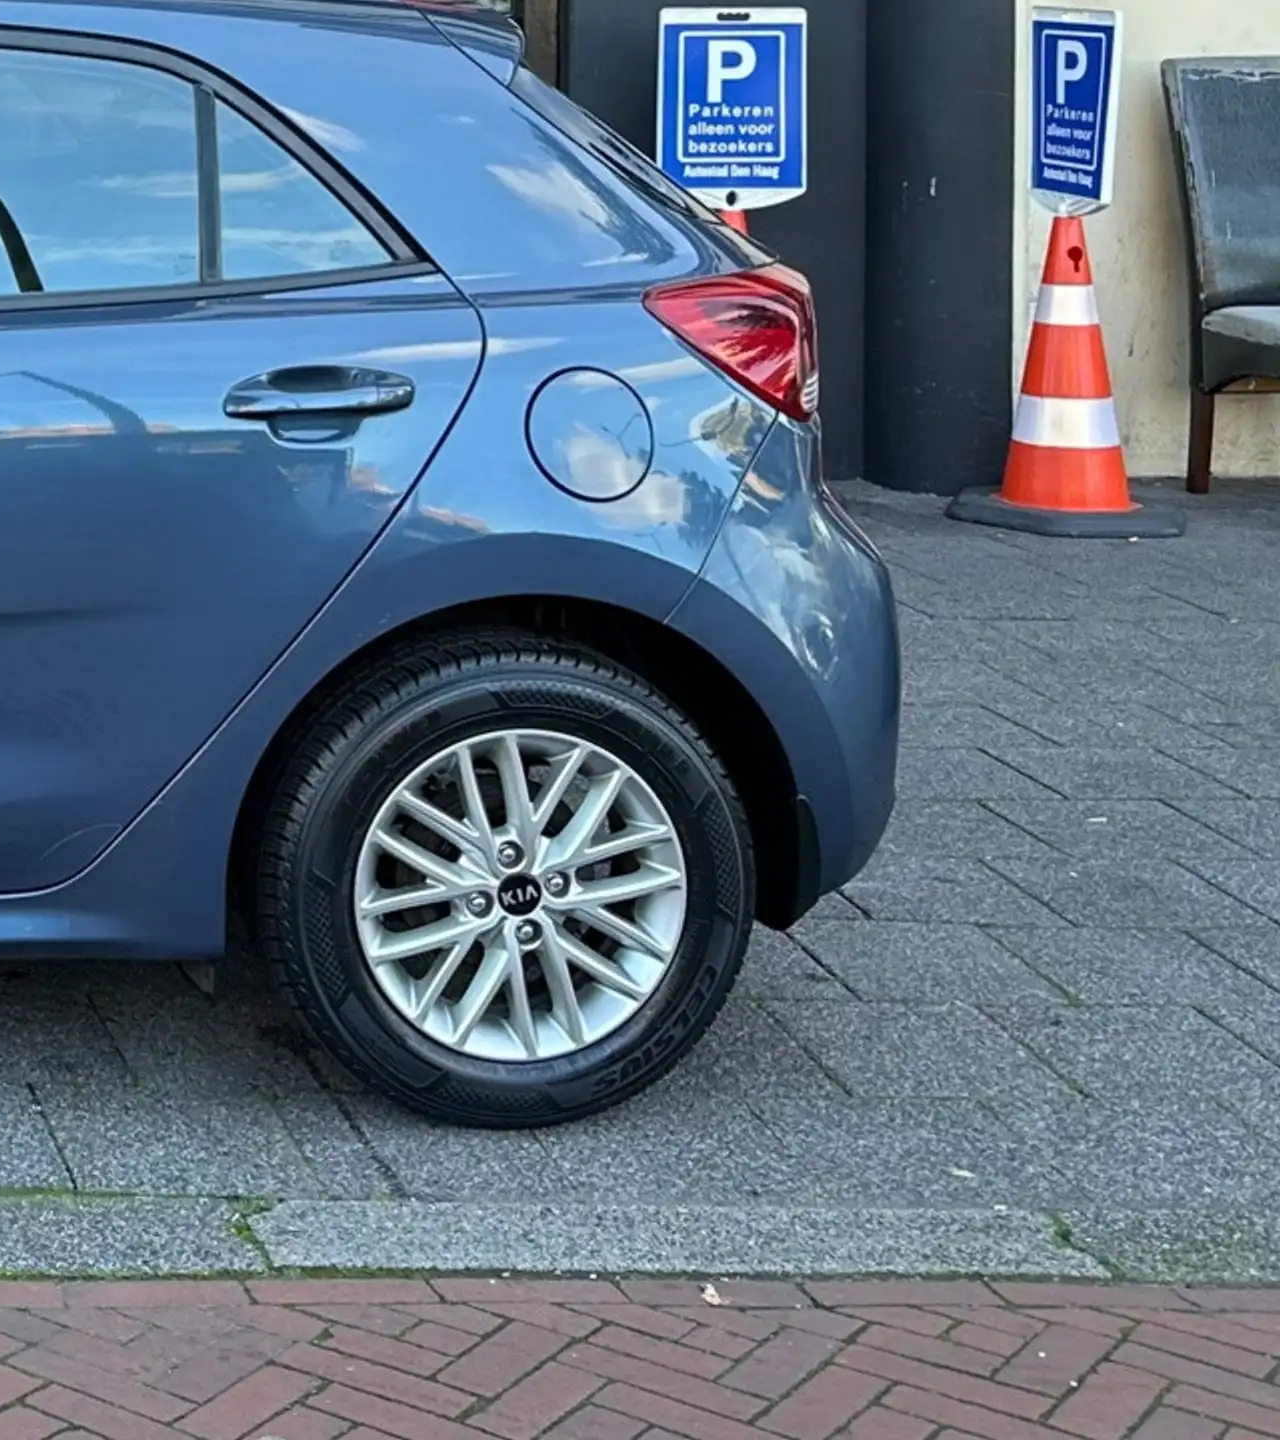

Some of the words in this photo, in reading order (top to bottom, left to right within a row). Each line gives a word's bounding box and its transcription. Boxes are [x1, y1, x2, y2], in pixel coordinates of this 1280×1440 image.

[707, 40, 757, 103] P
[1056, 39, 1087, 105] P
[688, 103, 774, 117] Parkeren
[688, 121, 734, 135] alleen
[739, 124, 774, 135] voor
[688, 139, 774, 153] bezoekers
[501, 884, 539, 906] KIA
[592, 963, 718, 1099] CELSIUS
